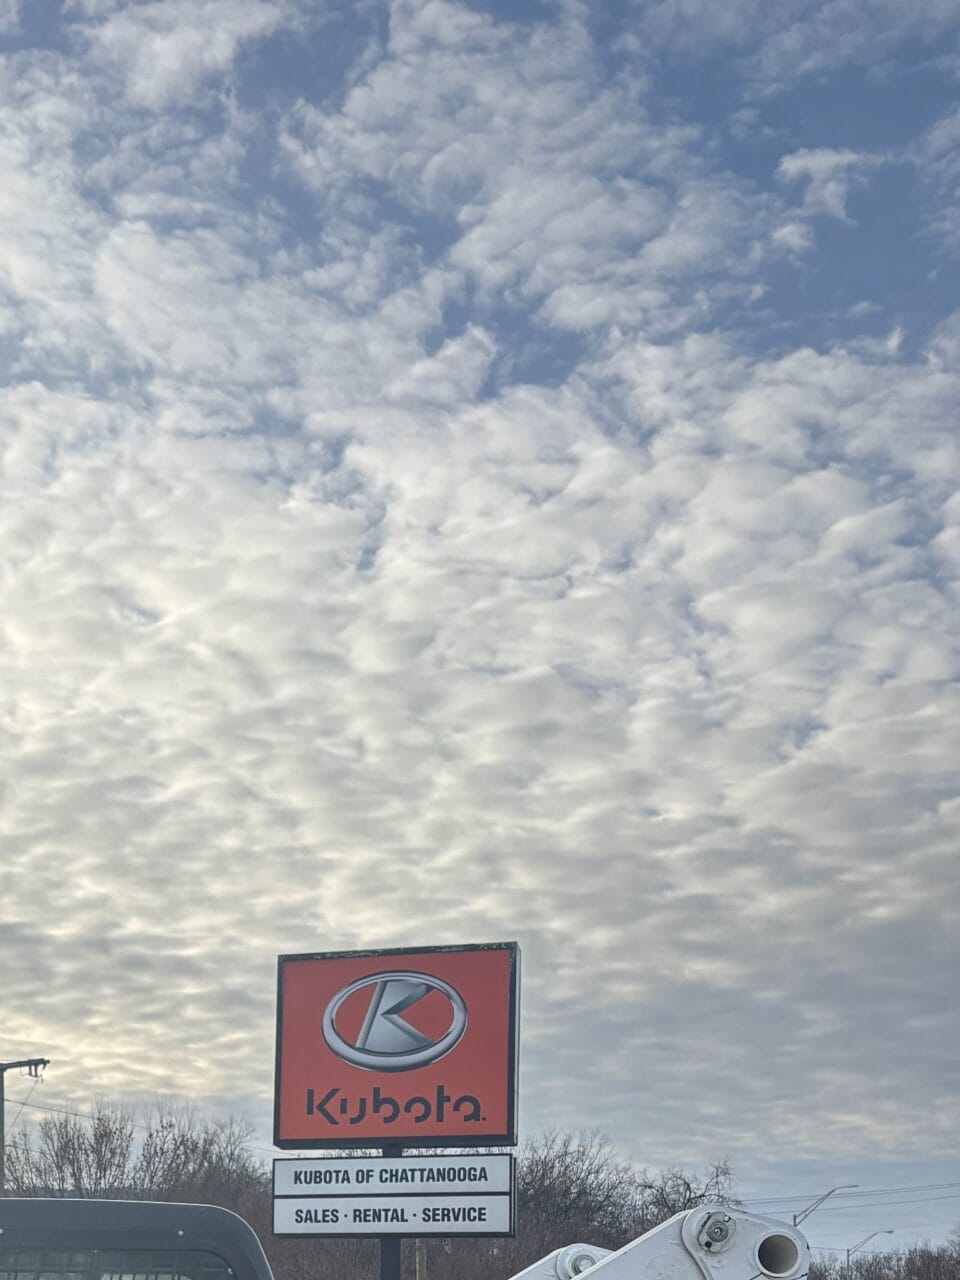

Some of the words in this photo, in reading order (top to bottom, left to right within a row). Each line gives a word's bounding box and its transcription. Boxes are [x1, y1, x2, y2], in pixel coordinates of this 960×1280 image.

[306, 1084, 482, 1126] Kubota
[293, 1169, 351, 1185] KUBOTA
[355, 1169, 375, 1184] OF
[378, 1167, 489, 1184] CHATTANOOGA
[294, 1208, 340, 1224] SALES
[352, 1208, 409, 1223] RENTAL
[421, 1206, 487, 1223] SERVICE
